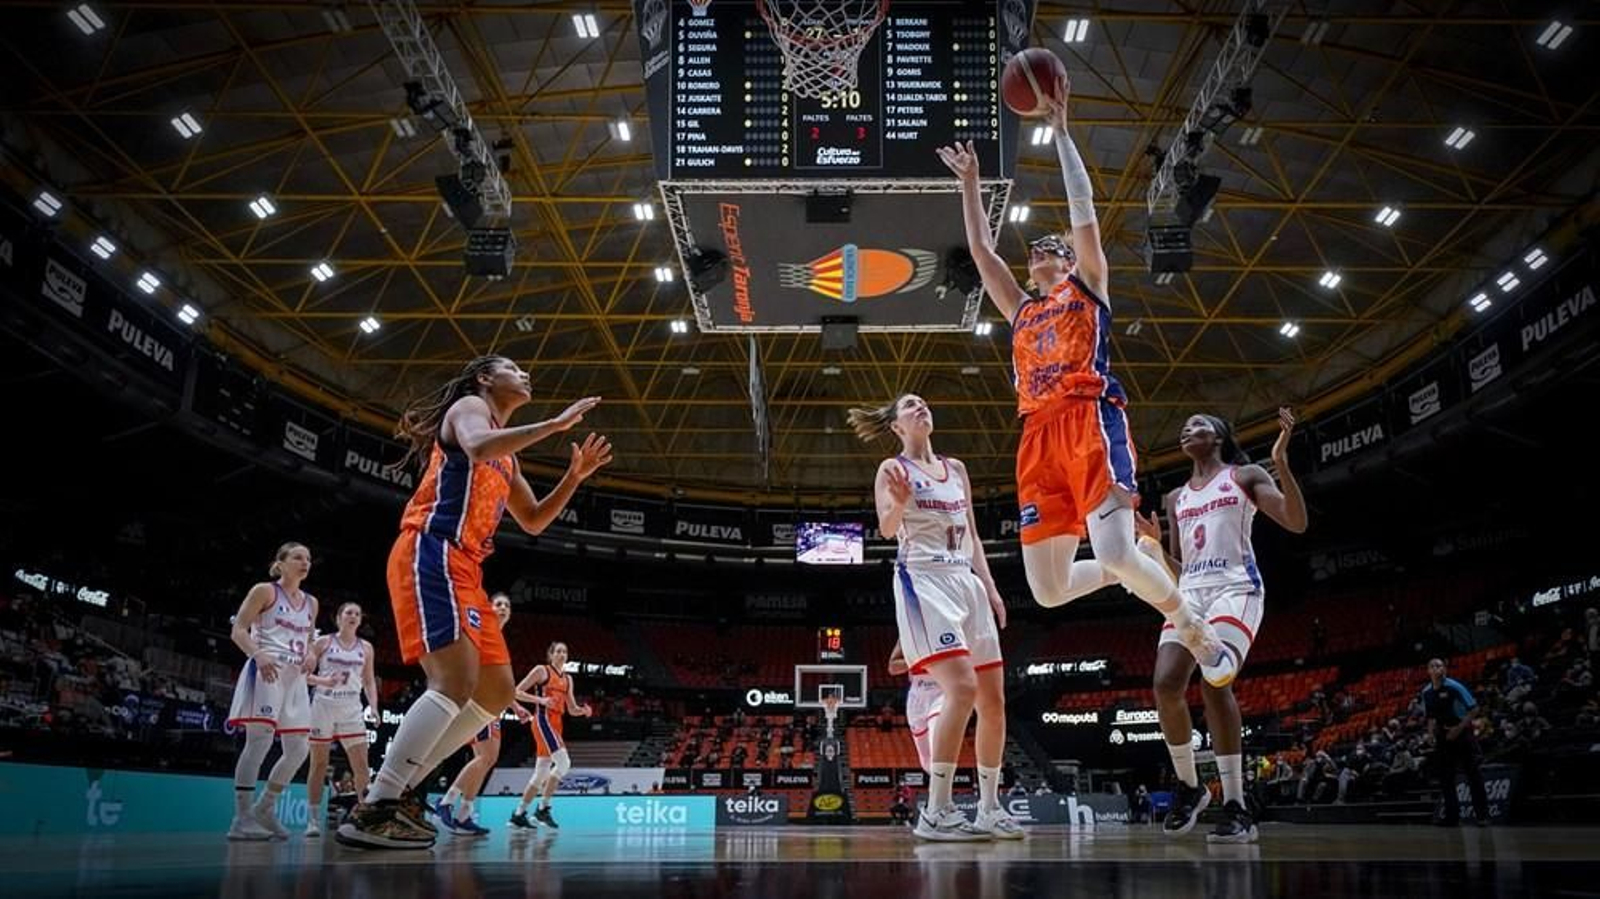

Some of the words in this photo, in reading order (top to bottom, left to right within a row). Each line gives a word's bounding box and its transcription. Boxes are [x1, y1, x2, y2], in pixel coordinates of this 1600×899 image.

[678, 18, 685, 26] 4
[678, 30, 685, 39] 5
[886, 31, 893, 39] 5
[988, 31, 995, 39] 0
[678, 44, 685, 52] 6
[687, 44, 717, 52] SEGURA
[886, 43, 893, 51] 7
[989, 43, 996, 51] 0
[678, 56, 685, 64] 8
[687, 56, 710, 64] ALLEN
[886, 56, 893, 64] 8
[989, 55, 996, 64] 0
[678, 68, 685, 77] 9
[687, 68, 712, 77] CASAS
[886, 68, 893, 76] 9
[989, 68, 996, 76] 7
[676, 81, 686, 90] 10
[687, 81, 720, 90] ROMERO
[886, 81, 896, 89] 13
[989, 81, 996, 89] 0
[676, 94, 686, 102] 12
[782, 94, 788, 102] 0
[821, 91, 860, 109] 5:10
[676, 107, 686, 115] 14
[687, 107, 722, 115] CARRERA
[782, 107, 788, 115] 2
[676, 120, 686, 128] 15
[687, 120, 700, 128] GIL
[782, 120, 788, 128] 4
[886, 119, 896, 127] 31
[991, 119, 997, 127] 0
[676, 133, 686, 141] 17
[782, 133, 788, 141] 0
[886, 132, 896, 140] 44
[991, 132, 997, 140] 2
[676, 145, 686, 154] 18
[782, 145, 788, 154] 2
[676, 158, 686, 166] 21
[782, 158, 788, 166] 0
[1522, 284, 1597, 352] PULEVA
[108, 308, 174, 371] PULEVA
[1321, 422, 1384, 462] PULEVA
[344, 449, 414, 489] PULEVA
[674, 521, 742, 540] PULEVA
[1194, 524, 1206, 551] 9
[726, 796, 780, 813] teika
[615, 801, 687, 824] teika
